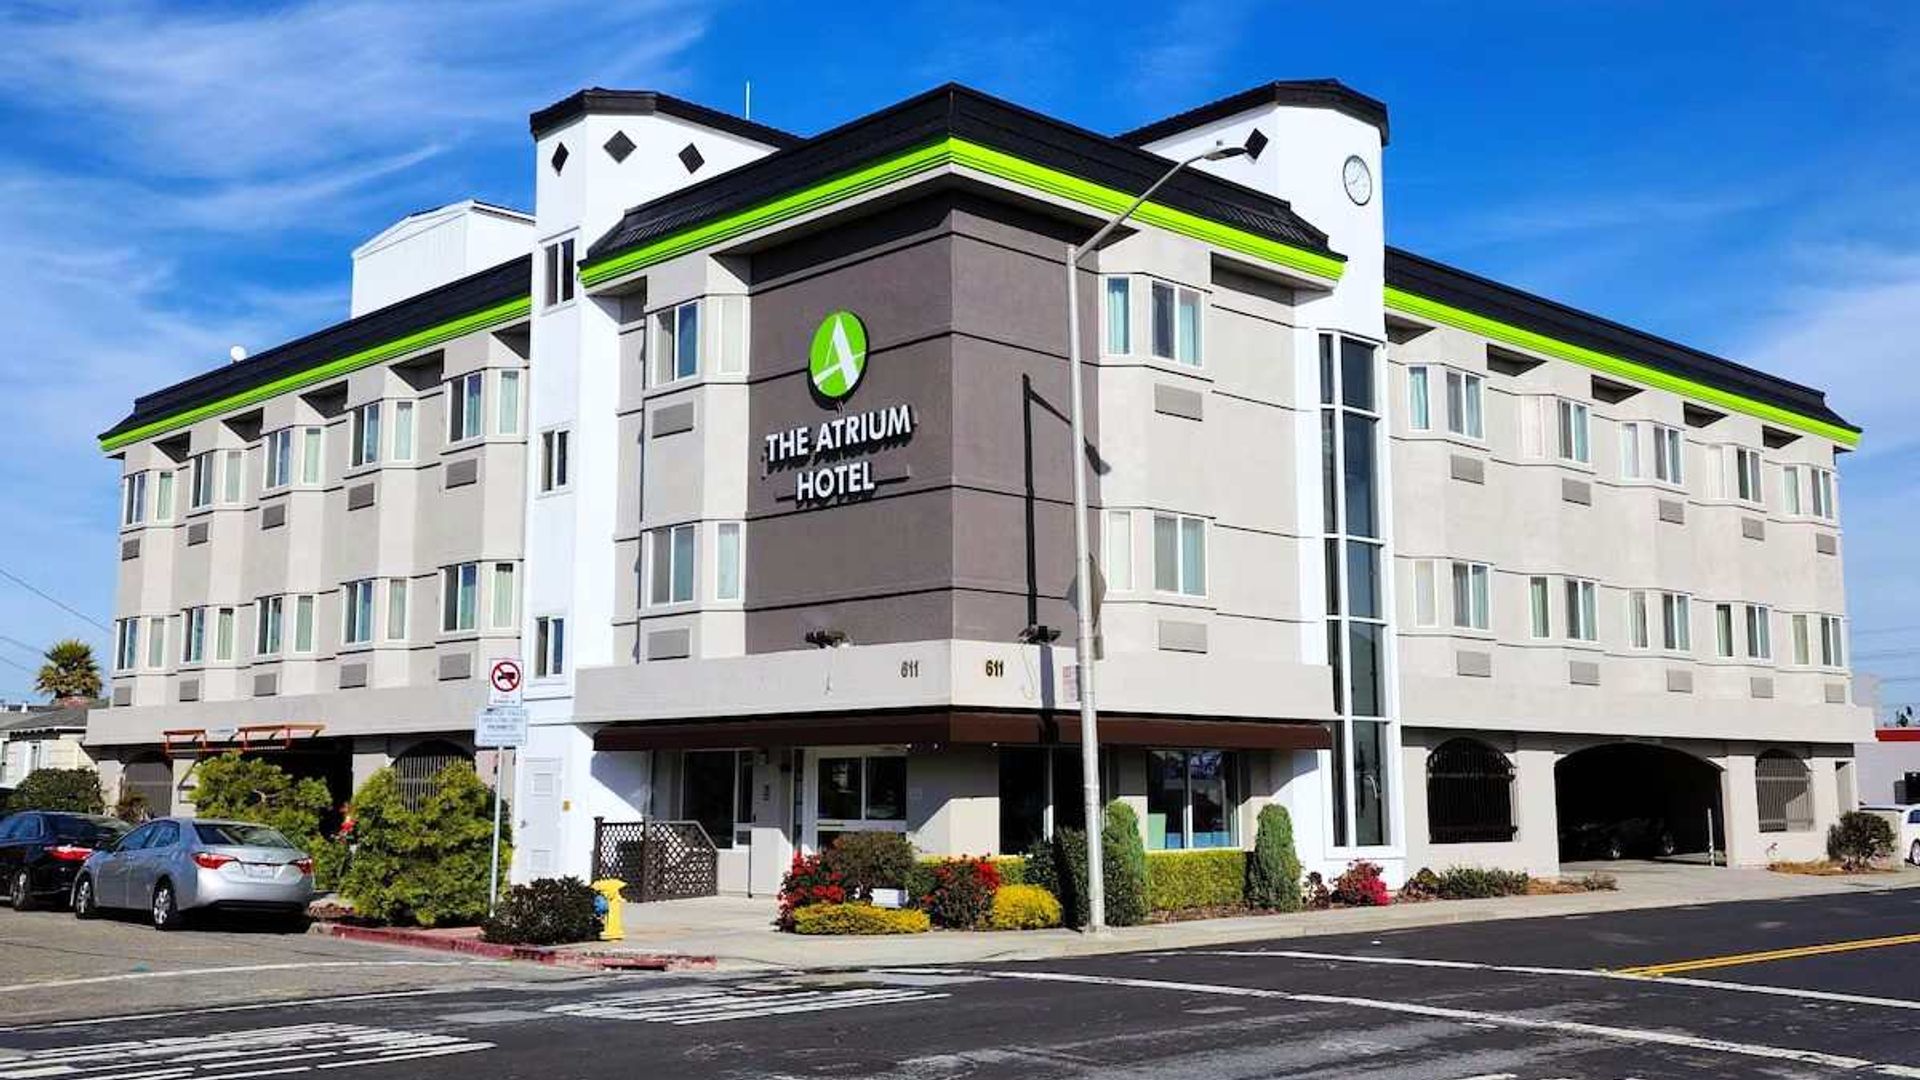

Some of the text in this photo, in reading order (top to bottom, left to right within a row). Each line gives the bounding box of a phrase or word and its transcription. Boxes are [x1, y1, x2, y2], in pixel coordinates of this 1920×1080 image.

[765, 404, 912, 462] THE ATRIUM
[796, 461, 875, 500] HOTEL
[901, 660, 919, 678] 611
[985, 660, 1004, 678] 611
